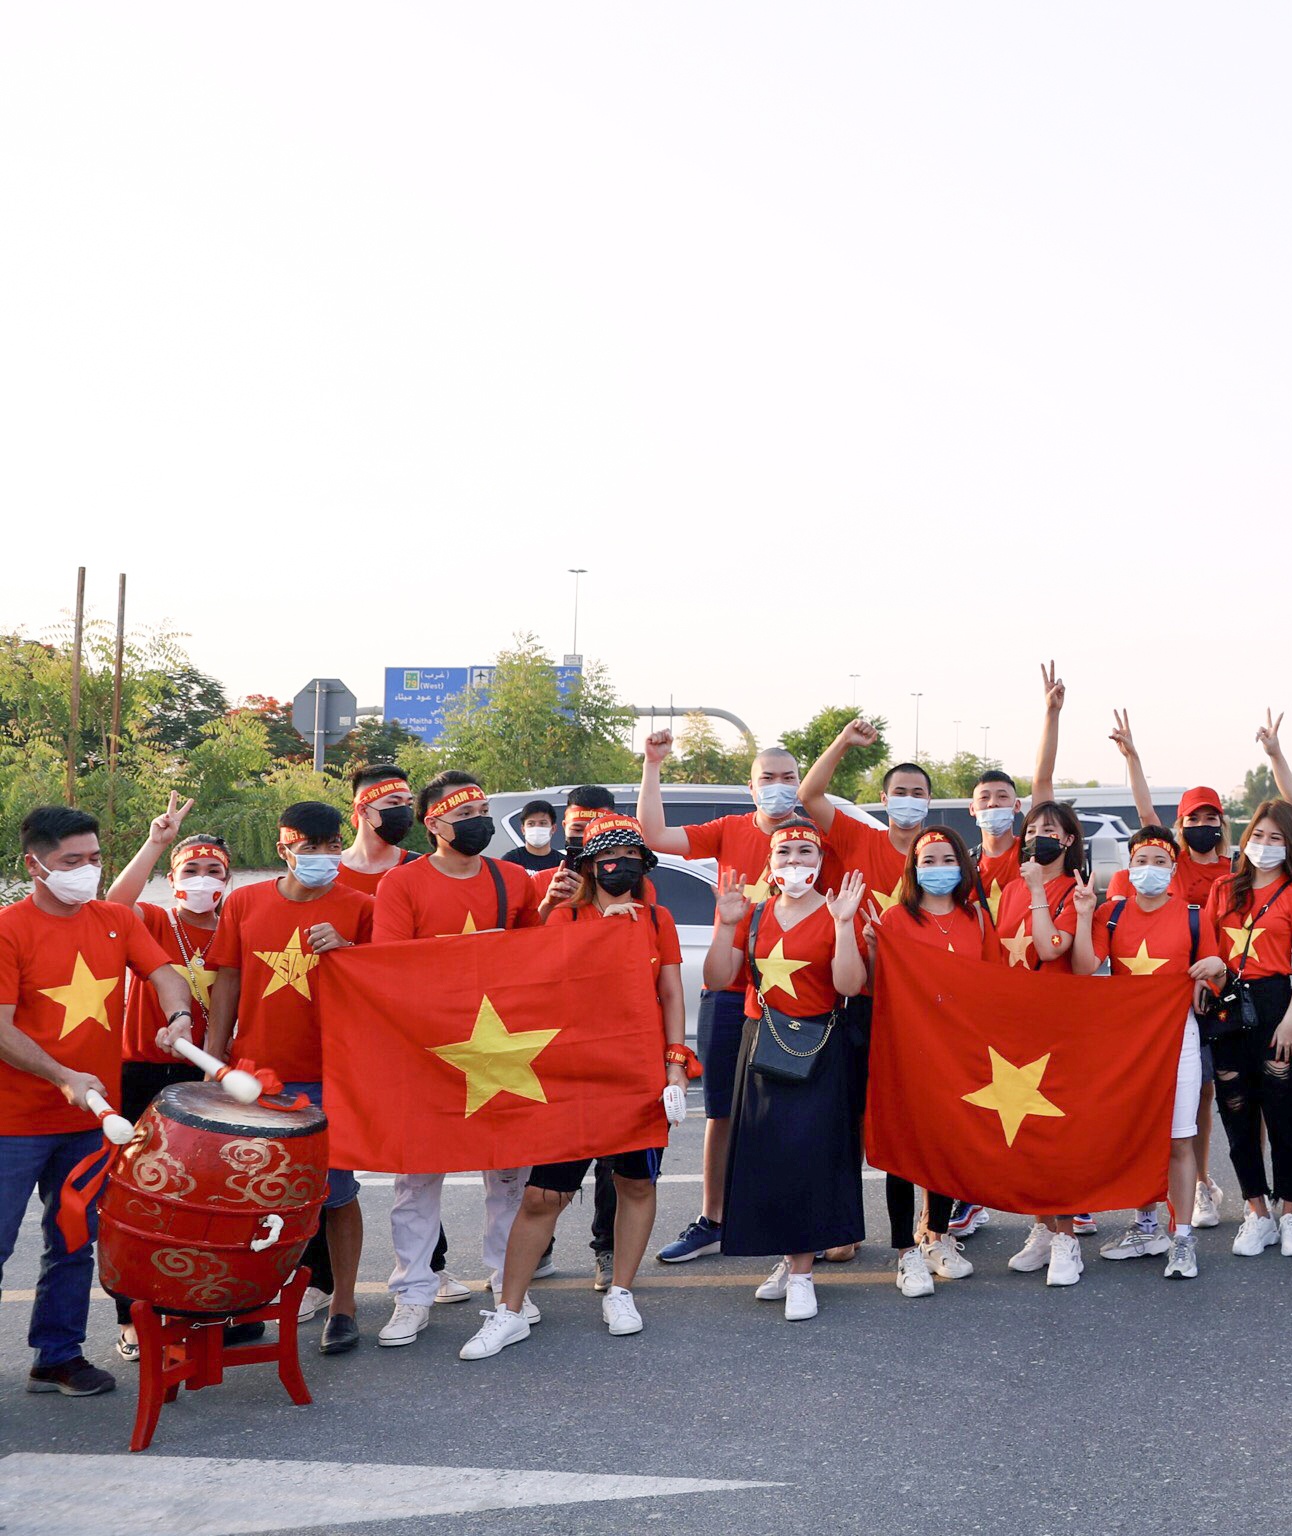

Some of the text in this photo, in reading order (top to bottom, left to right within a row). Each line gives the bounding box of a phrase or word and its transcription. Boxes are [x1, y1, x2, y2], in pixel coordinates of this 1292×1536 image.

[420, 682, 445, 690] (West)
[380, 783, 396, 795] NAM
[447, 790, 470, 808] NAM
